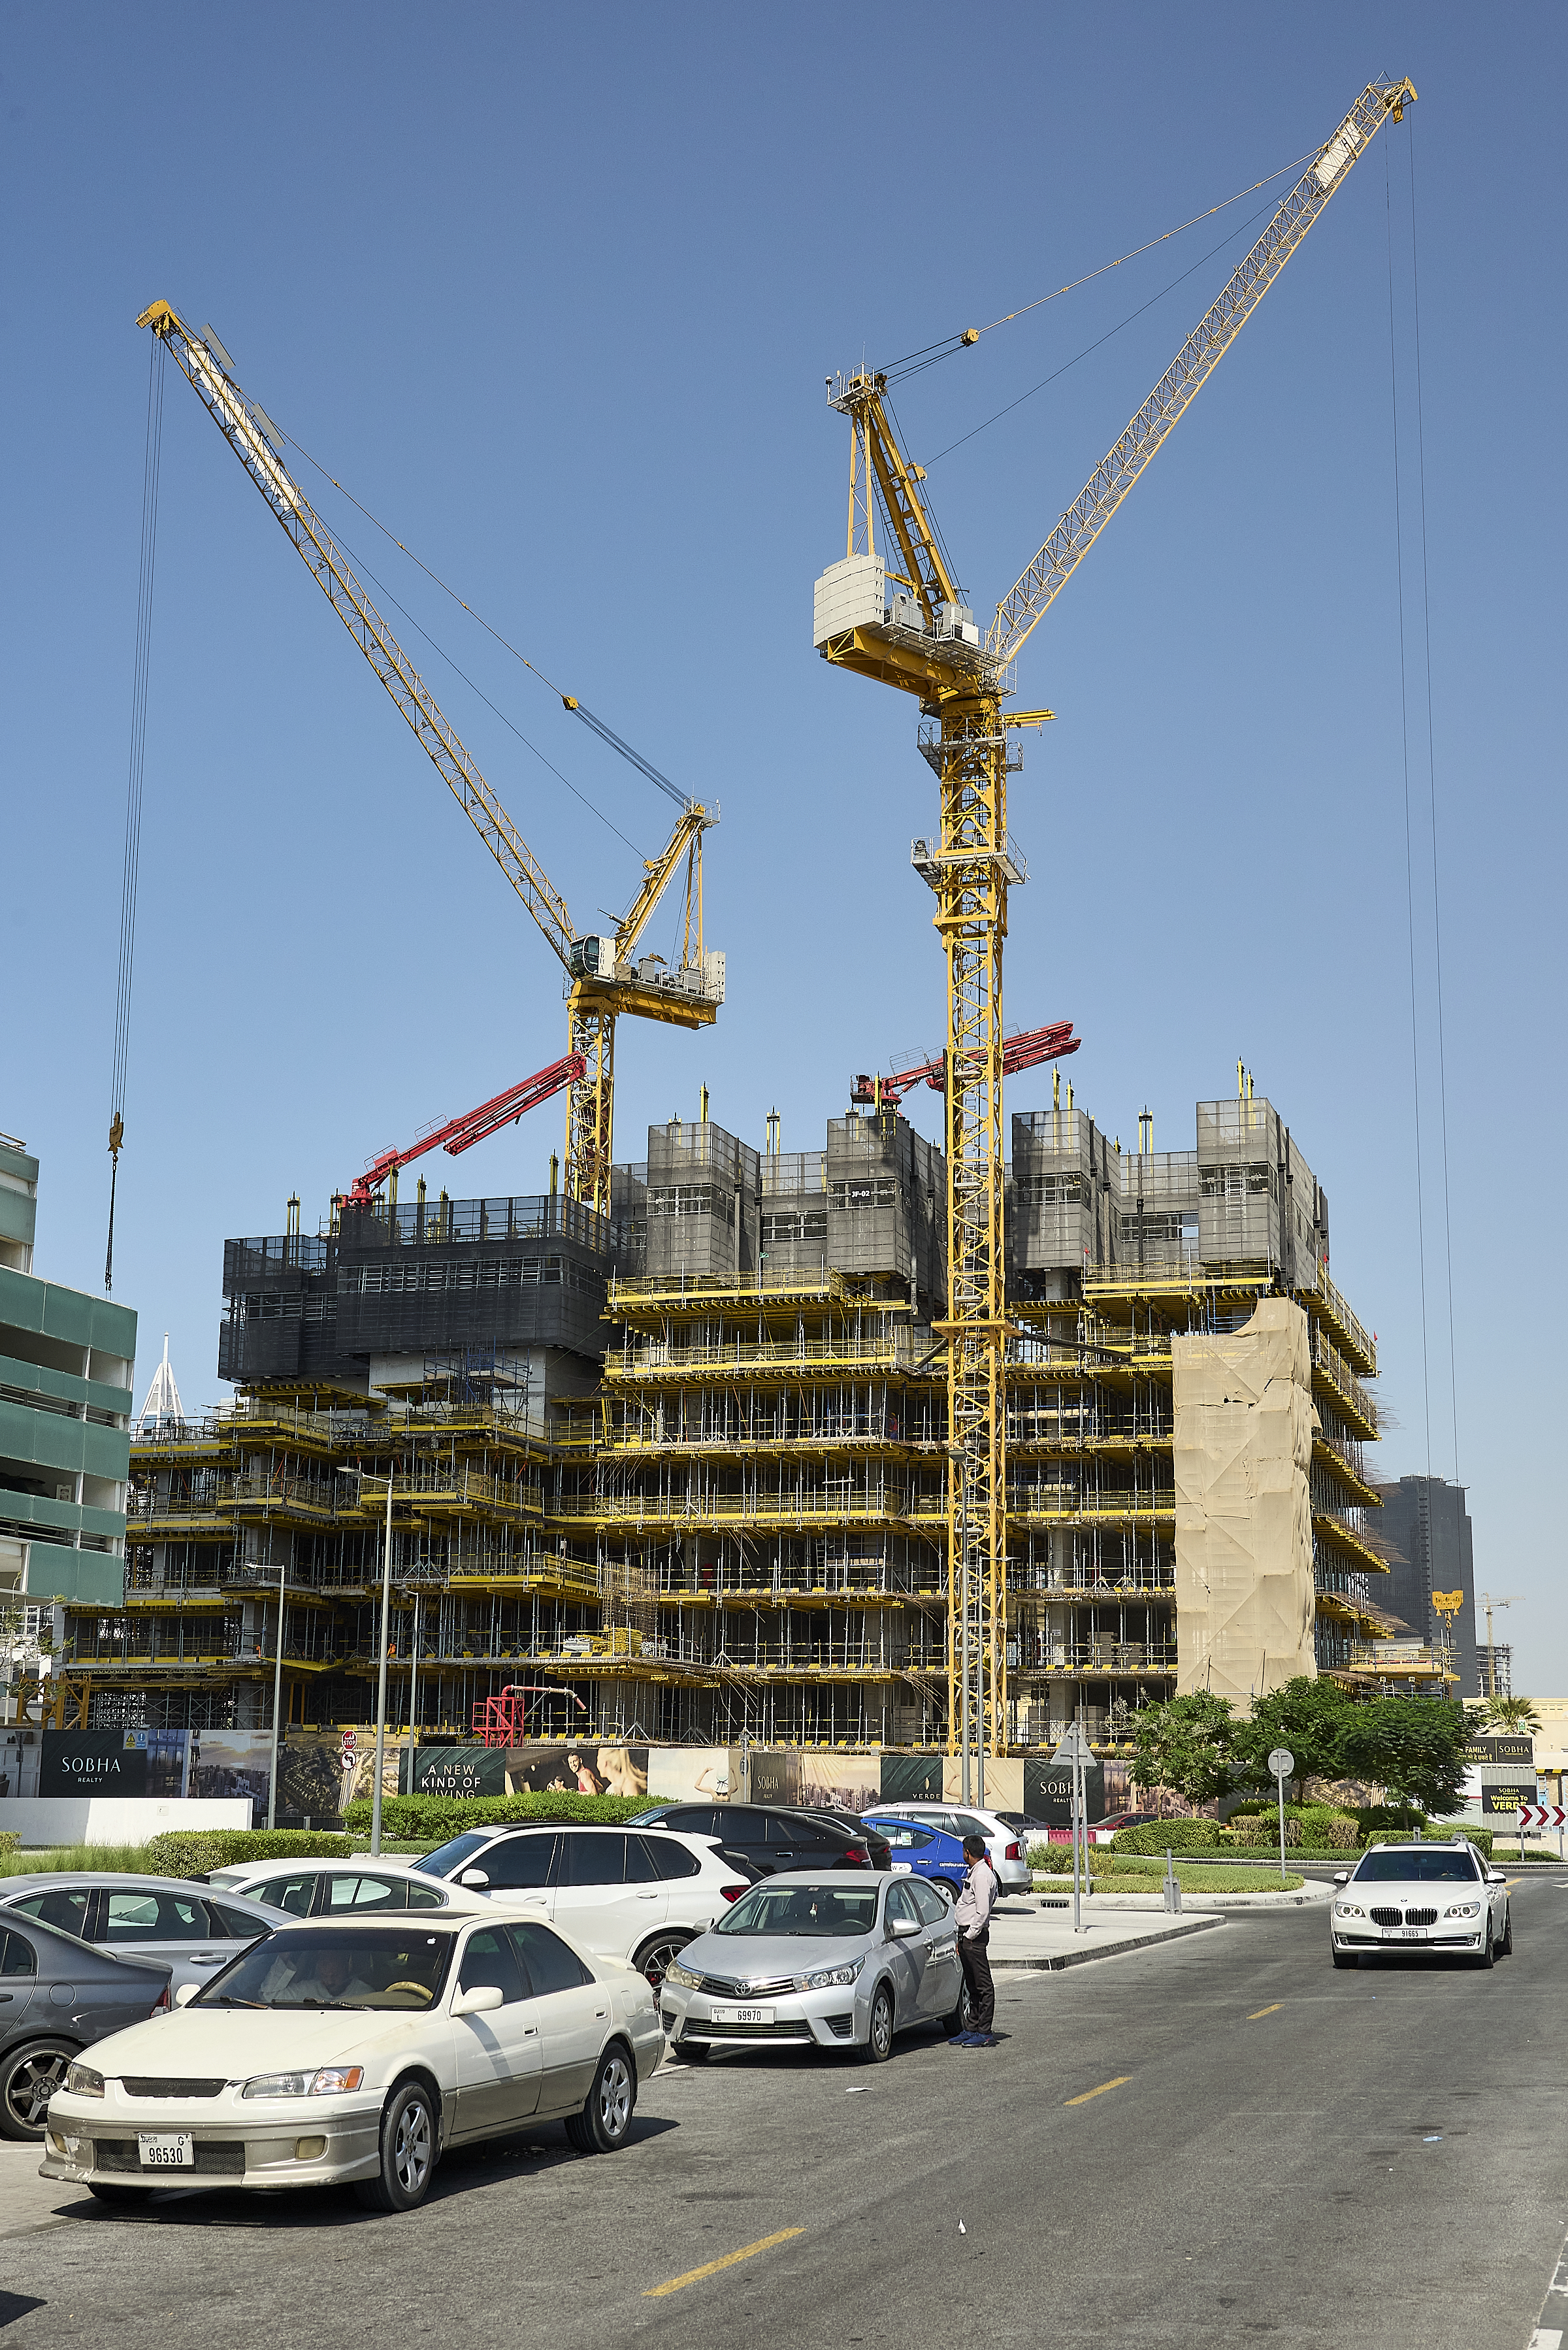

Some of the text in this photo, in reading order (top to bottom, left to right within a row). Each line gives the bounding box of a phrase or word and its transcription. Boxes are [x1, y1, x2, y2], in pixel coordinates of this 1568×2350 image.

[61, 1757, 121, 1772] SOBHA
[428, 1764, 475, 1776] A NEW
[421, 1777, 481, 1788] KIND OF
[758, 1775, 779, 1789] SOBHA
[738, 2010, 761, 2021] 69970
[178, 2136, 184, 2146] G
[149, 2147, 183, 2163] 96530
